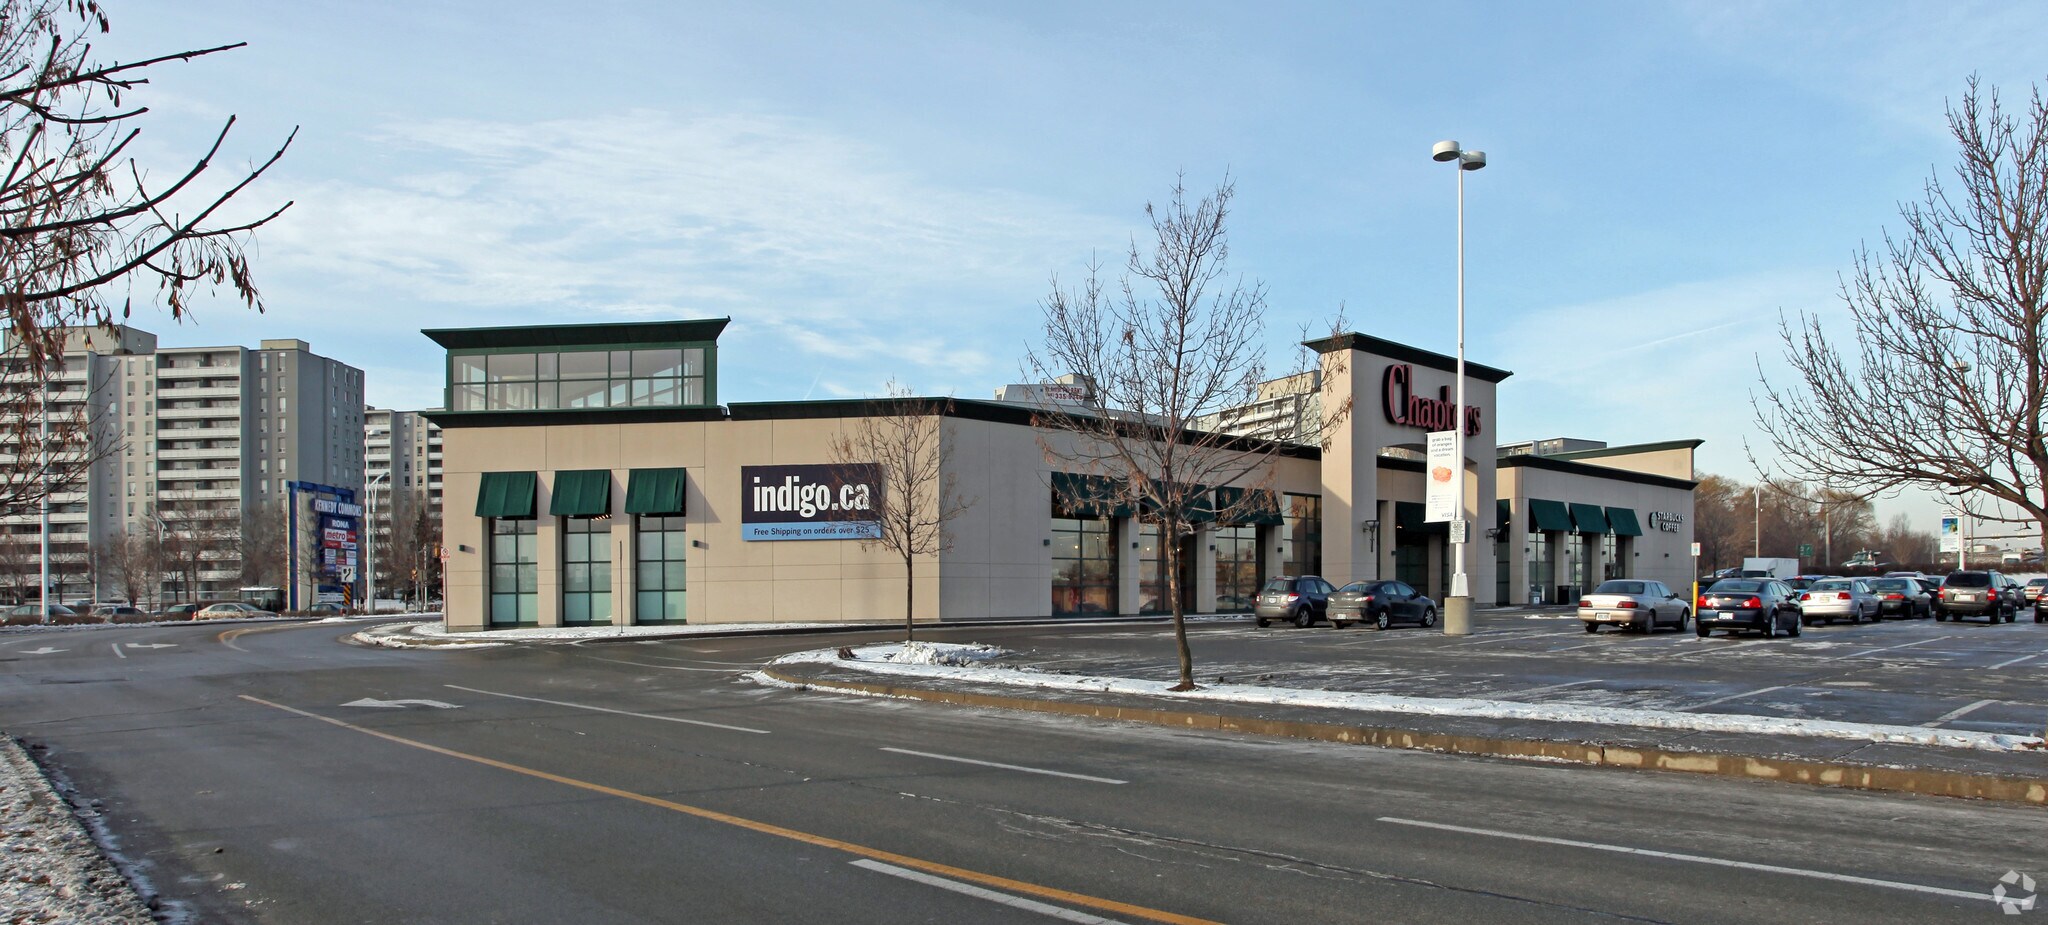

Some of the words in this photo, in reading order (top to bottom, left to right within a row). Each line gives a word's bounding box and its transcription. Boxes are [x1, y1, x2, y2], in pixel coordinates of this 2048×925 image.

[753, 475, 870, 518] indigo.ca
[315, 499, 337, 513] KENNEDY
[338, 502, 362, 517] COMMONS
[331, 519, 350, 529] RONA
[1662, 522, 1679, 532] COFFEE
[325, 531, 346, 540] metro
[754, 528, 769, 536] Free
[771, 527, 801, 537] Shipping
[814, 527, 837, 535] orders
[839, 527, 853, 535] over
[855, 526, 870, 534] $25
